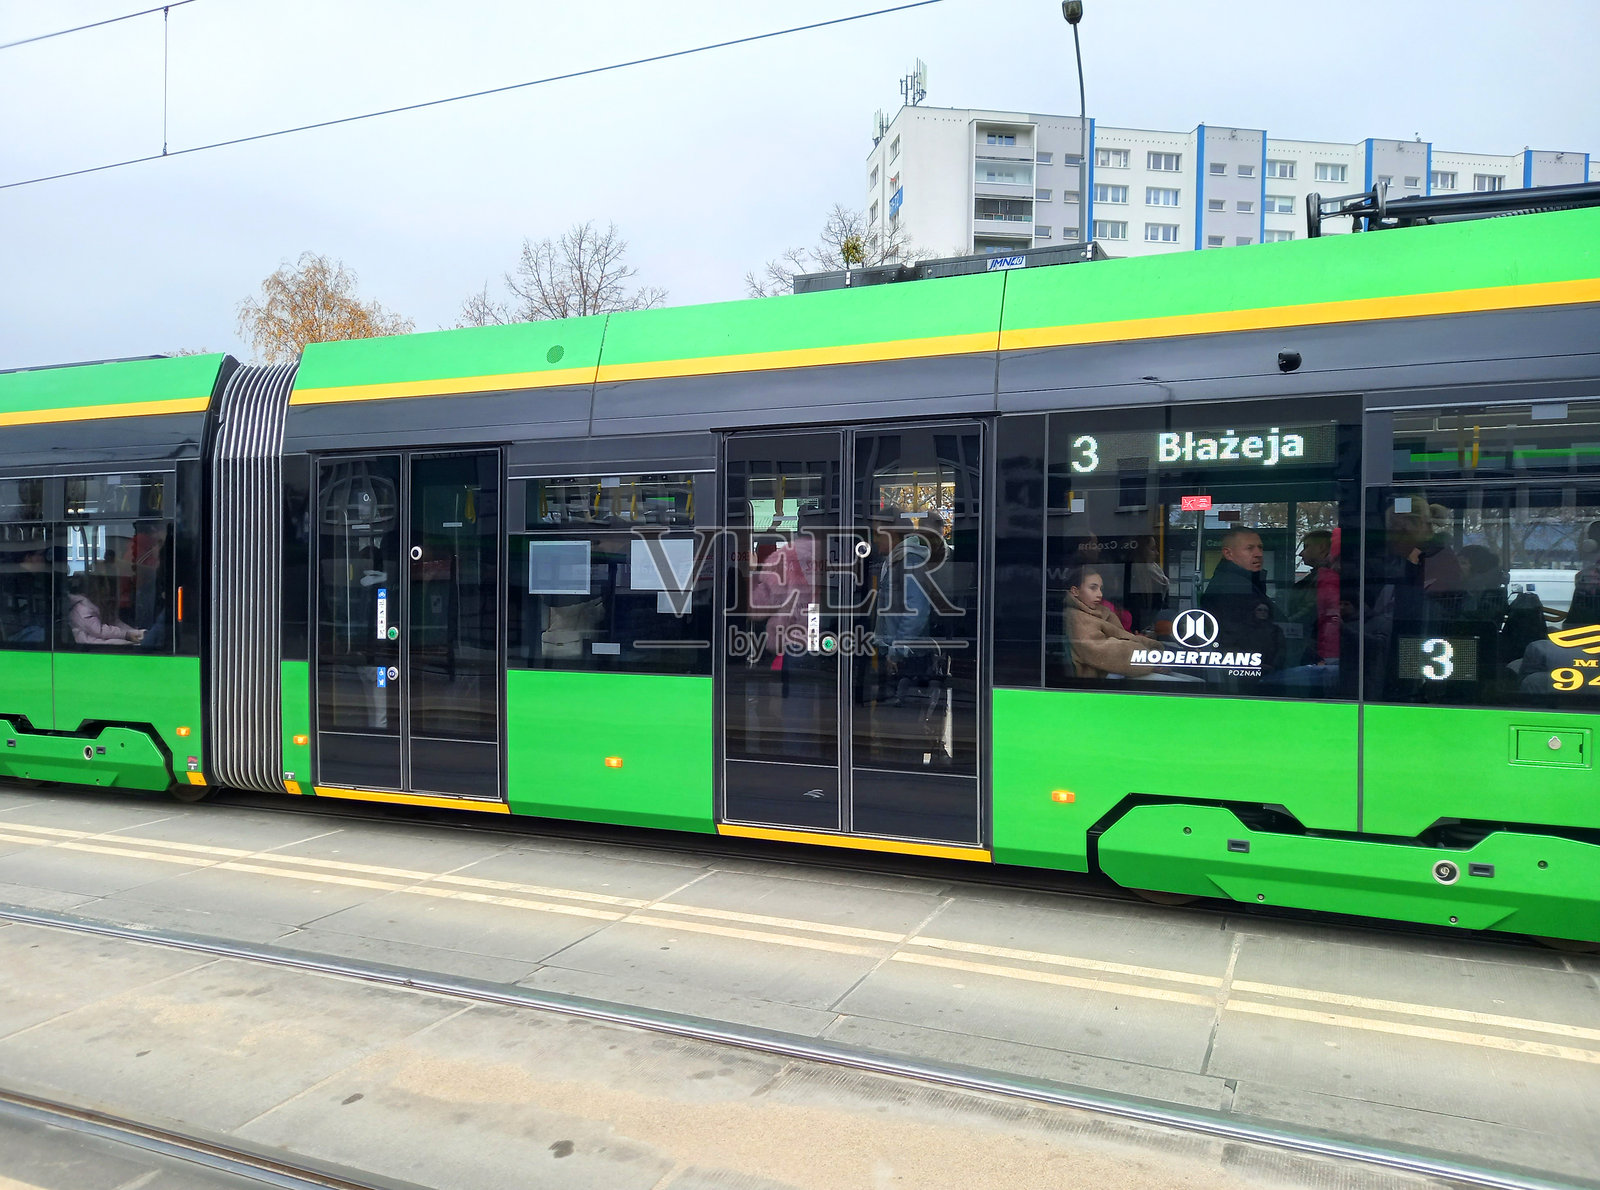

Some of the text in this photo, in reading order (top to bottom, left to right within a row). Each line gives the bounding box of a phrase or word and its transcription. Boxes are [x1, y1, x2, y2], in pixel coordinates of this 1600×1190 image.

[1071, 427, 1304, 473] 3 Błażeja
[1130, 649, 1262, 666] MODERTRANS
[1422, 638, 1454, 680] 3
[1228, 669, 1262, 677] POZNAŃ
